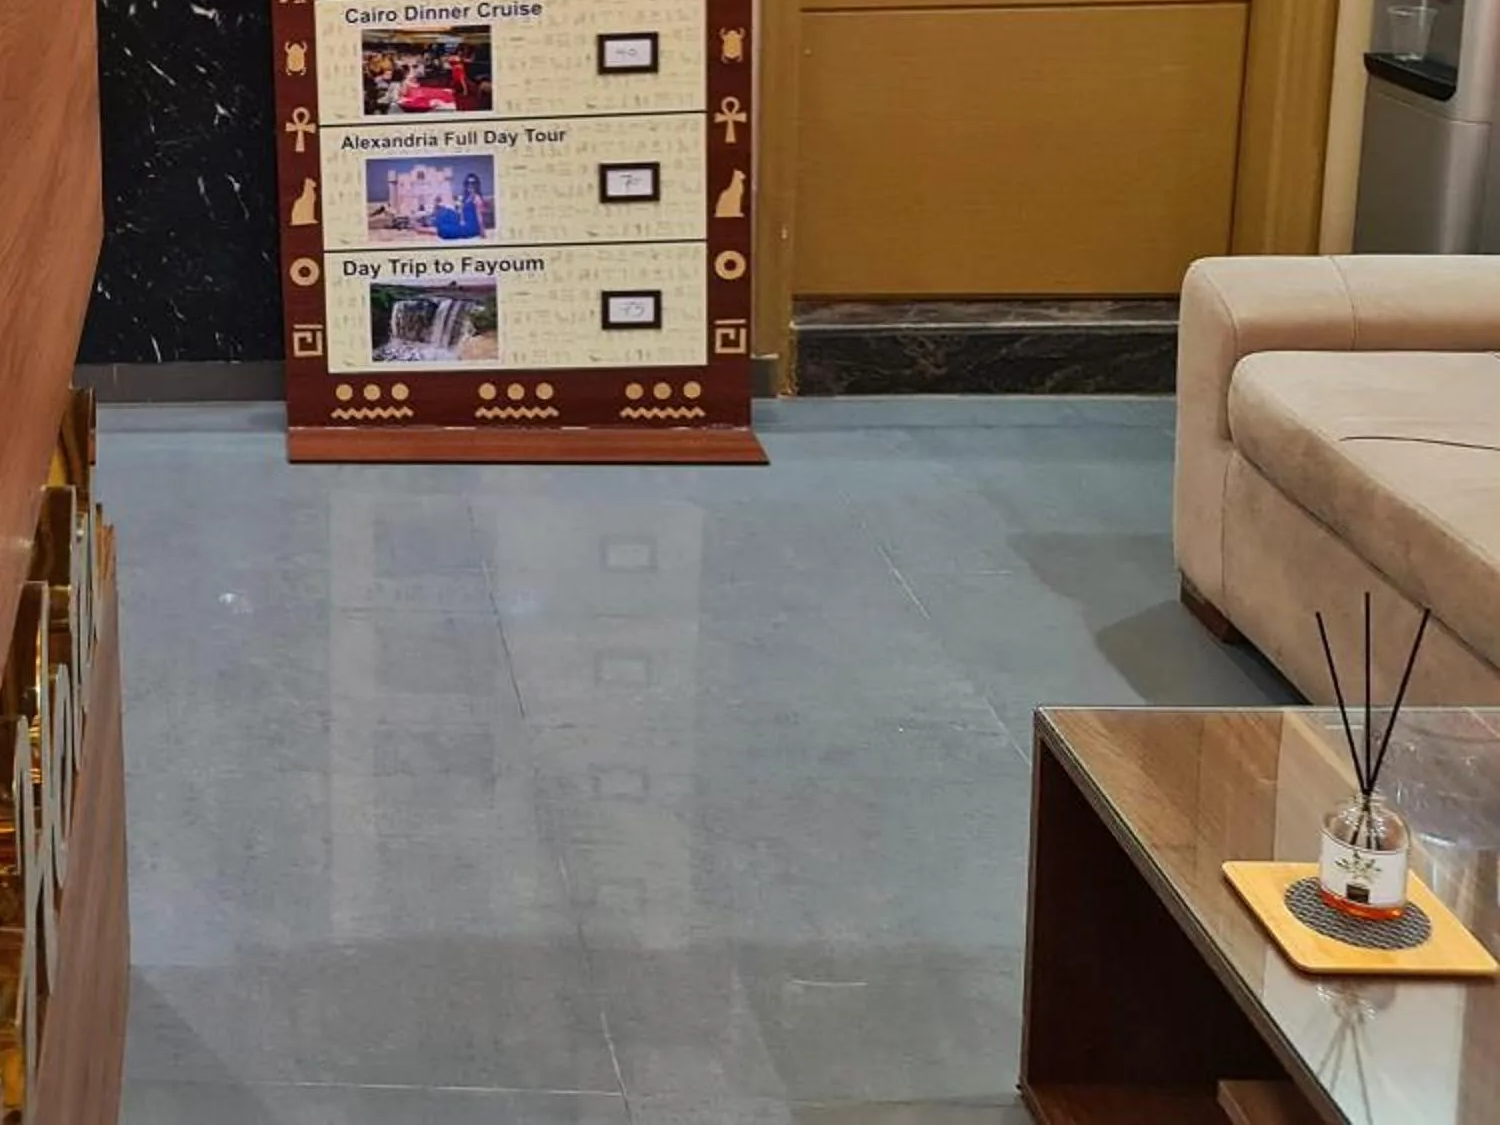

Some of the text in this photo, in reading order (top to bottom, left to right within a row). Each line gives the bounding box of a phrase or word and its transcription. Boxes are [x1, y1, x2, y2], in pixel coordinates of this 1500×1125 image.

[345, 1, 543, 24] Cairo Dinner Cruise
[341, 128, 568, 150] Alexandria Full Day Tour
[343, 256, 546, 279] Day Trip to Fayoum
